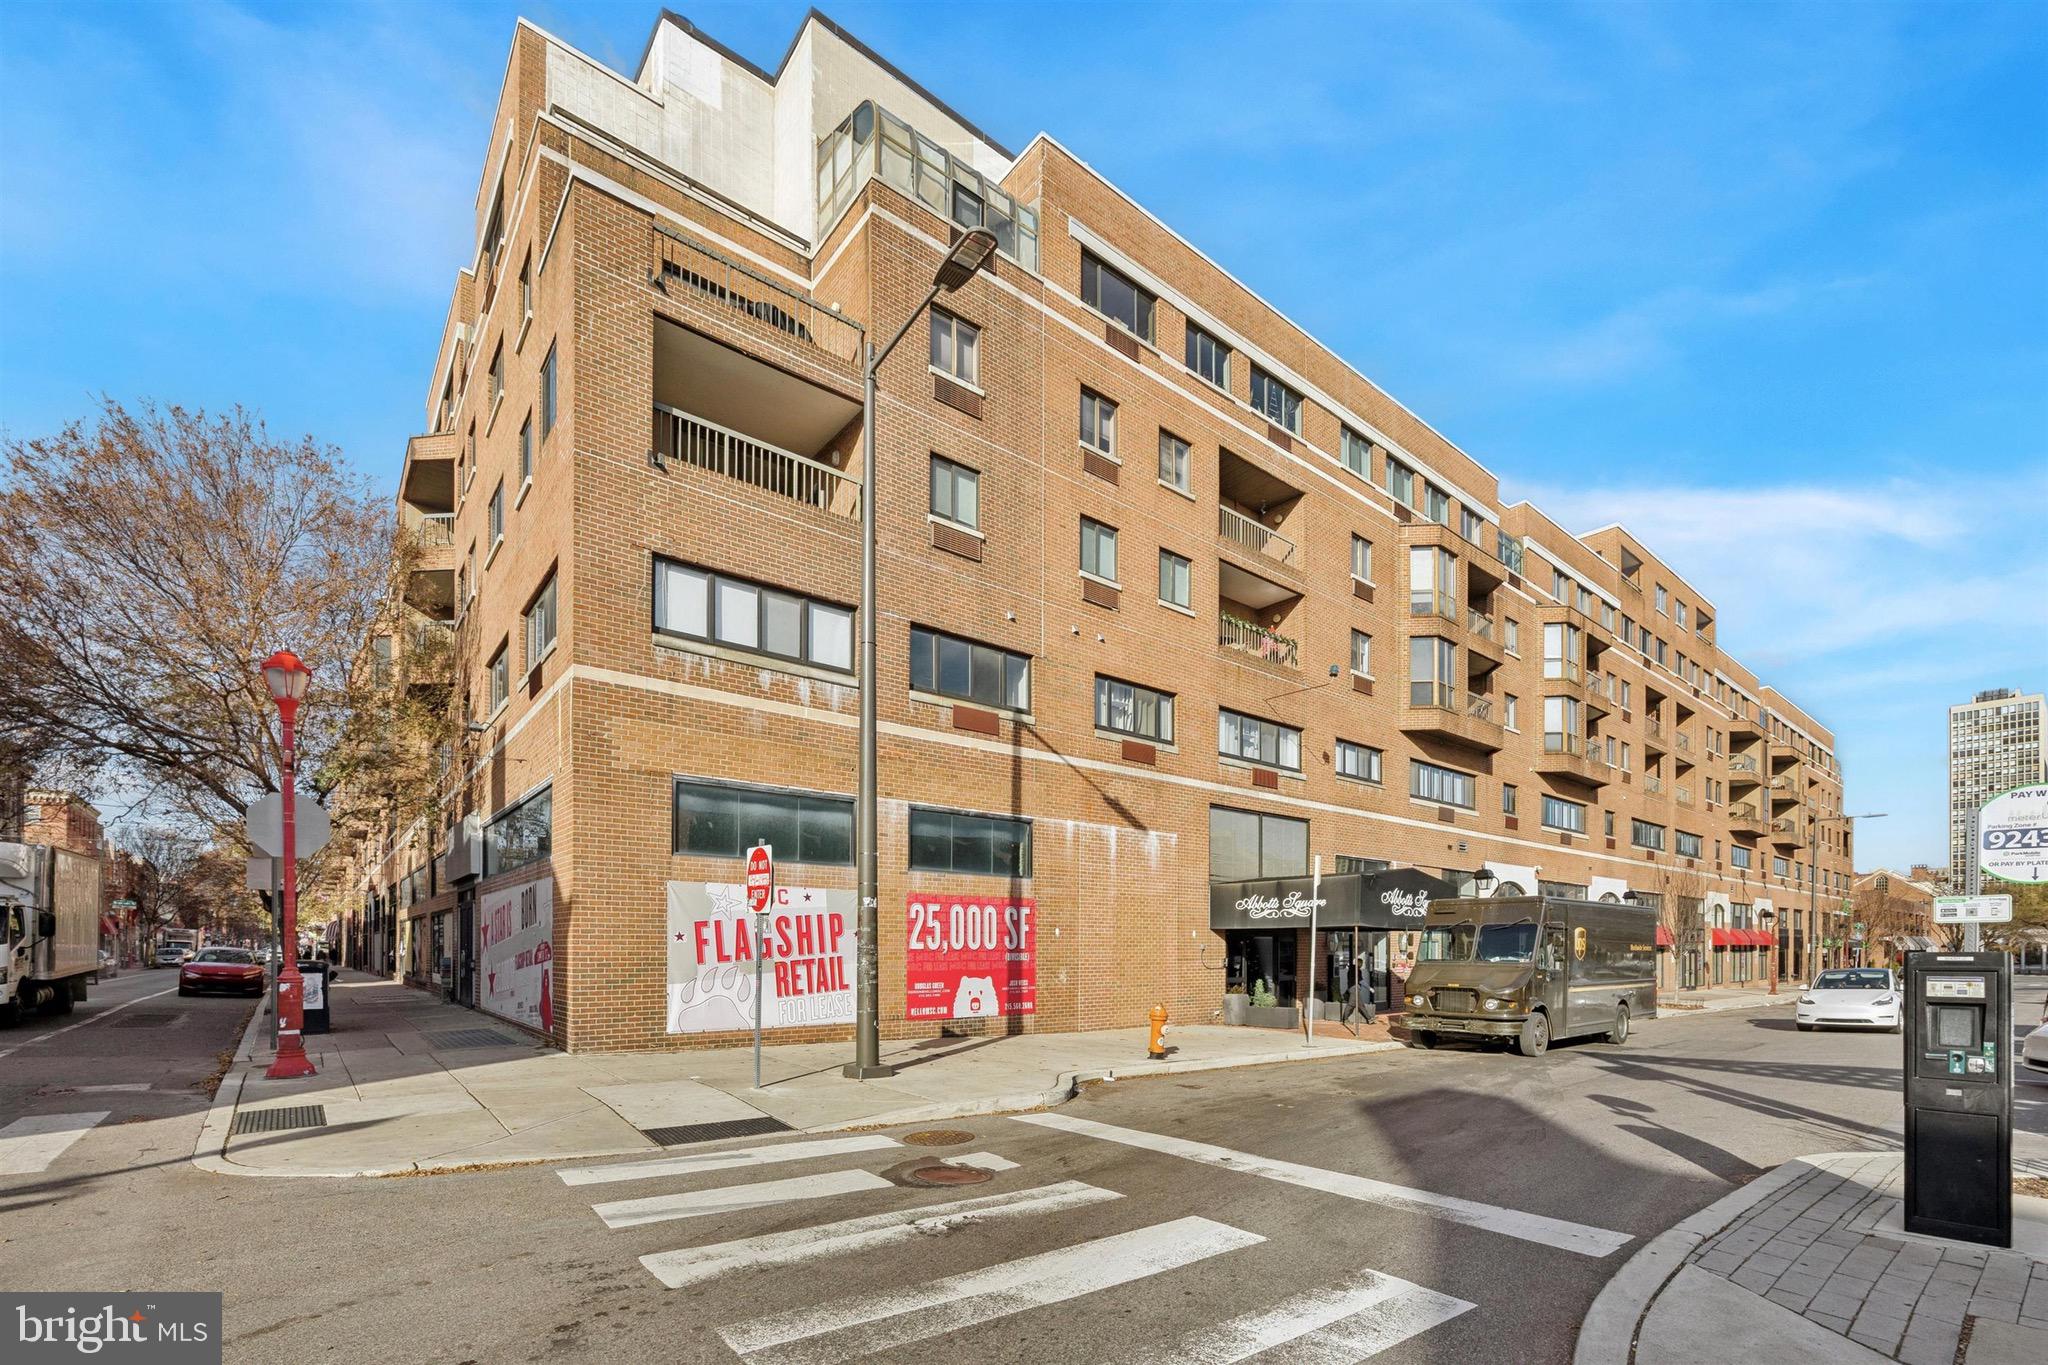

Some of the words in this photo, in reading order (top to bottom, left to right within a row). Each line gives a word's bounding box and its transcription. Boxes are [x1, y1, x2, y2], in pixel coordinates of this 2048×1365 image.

[2010, 791, 2033, 799] PAY
[750, 861, 757, 871] DO
[758, 859, 768, 870] NOT
[909, 902, 997, 954] 25,000
[1004, 906, 1031, 950] SF
[774, 956, 850, 999] RETAIL
[778, 999, 808, 1026] FOR
[811, 994, 853, 1021] LEASE
